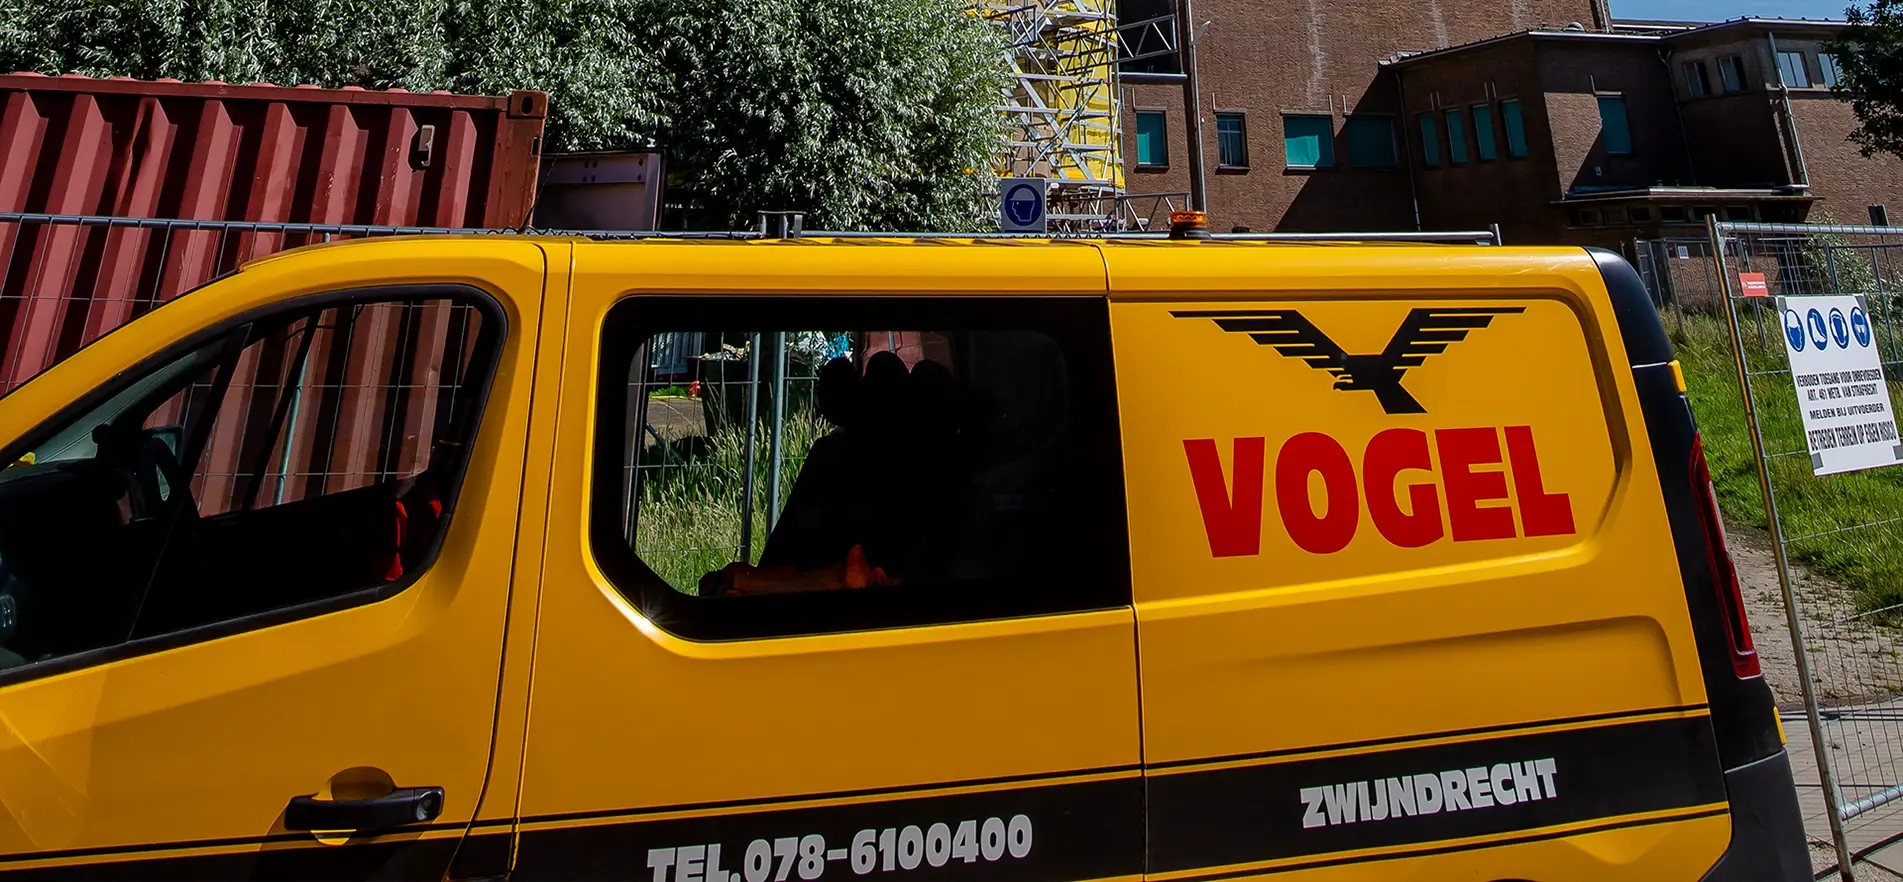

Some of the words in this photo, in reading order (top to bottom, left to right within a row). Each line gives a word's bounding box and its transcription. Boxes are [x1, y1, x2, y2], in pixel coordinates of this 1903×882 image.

[1809, 408, 1836, 420] MELDEN
[1836, 407, 1847, 417] BIJ
[1847, 403, 1885, 416] UITVOERDER
[1182, 425, 1576, 558] VOGEL
[1300, 758, 1557, 828] ZWIJNDRECHT
